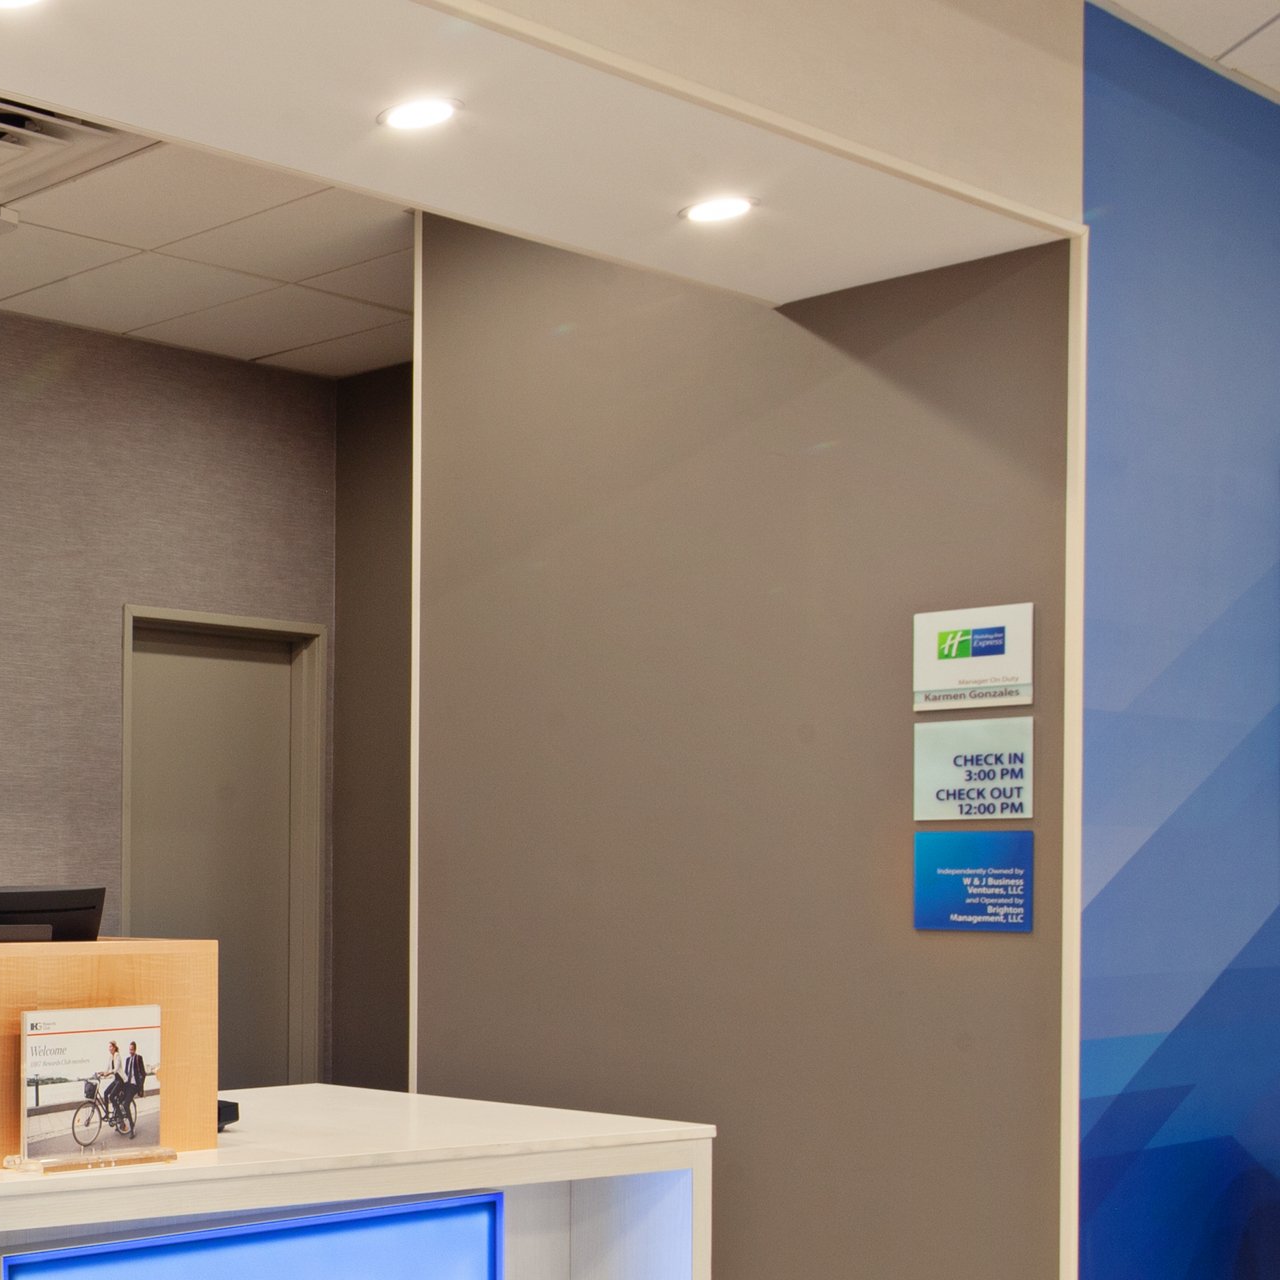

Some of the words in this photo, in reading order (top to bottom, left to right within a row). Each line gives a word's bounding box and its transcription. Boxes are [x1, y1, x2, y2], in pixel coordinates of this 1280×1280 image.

[973, 639, 1003, 647] Express
[924, 692, 966, 702] Karmen
[968, 688, 1020, 699] Gonzales
[953, 753, 1004, 767] CHECK
[1008, 752, 1024, 765] IN
[964, 769, 996, 782] 3:00
[1000, 767, 1024, 780] PM
[935, 788, 986, 802] CHECK
[990, 786, 1023, 800] OUT
[958, 802, 996, 816] 12:00
[1000, 802, 1024, 814] PM
[937, 868, 986, 876] Independently
[1015, 868, 1025, 876] by
[962, 877, 972, 886] W
[973, 877, 980, 886] &
[987, 877, 1024, 886] Business
[967, 886, 1007, 895] Ventures,
[1008, 886, 1024, 895] LLC
[980, 897, 1014, 905] Operated
[1015, 897, 1025, 905] by
[987, 905, 1025, 916] Brighton
[950, 914, 1007, 924] Management,
[1008, 914, 1024, 923] LLC
[30, 1045, 67, 1057] Welcome
